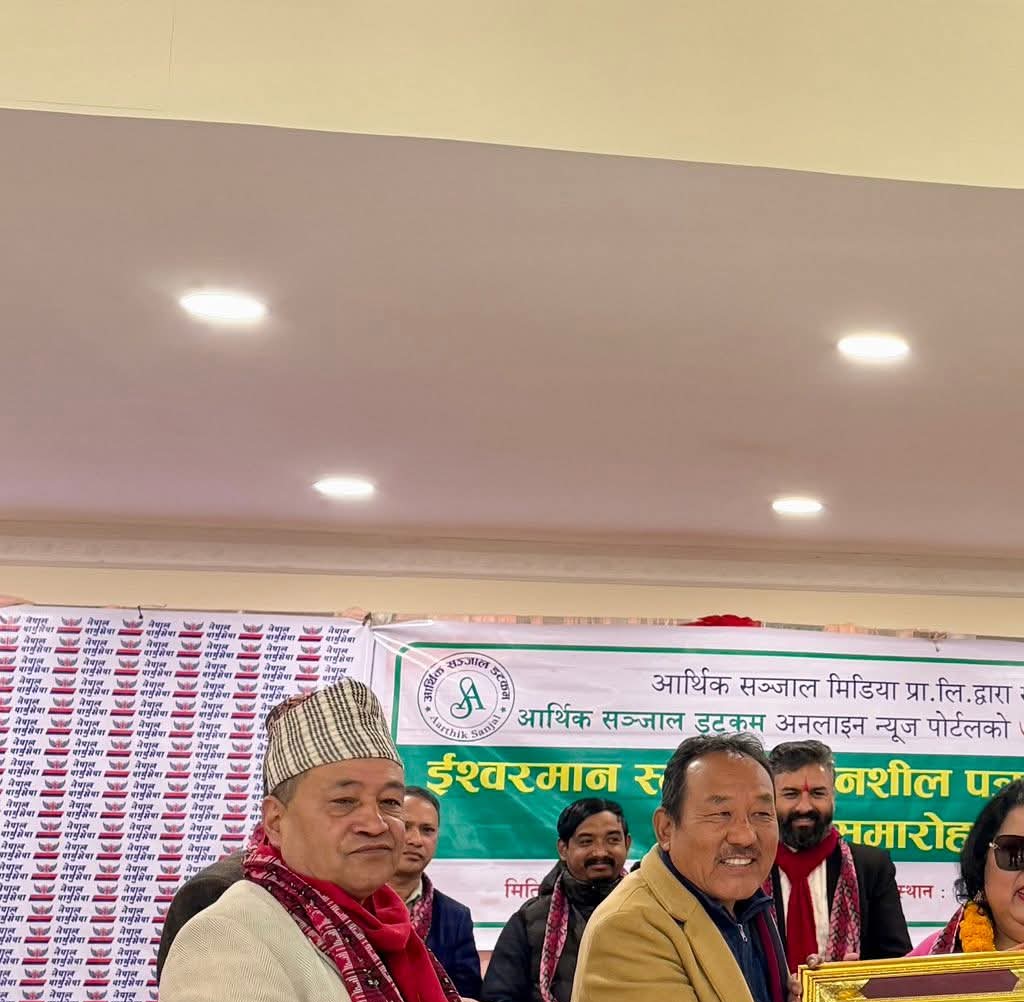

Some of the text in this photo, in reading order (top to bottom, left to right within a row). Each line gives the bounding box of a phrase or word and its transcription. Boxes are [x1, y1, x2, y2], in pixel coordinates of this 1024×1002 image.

[424, 666, 444, 702] आर्थिक
[446, 657, 490, 669] सञ्जाल
[652, 668, 732, 695] आर्थिक
[740, 676, 820, 697] सञ्जाल
[827, 675, 900, 699] मिडिया
[430, 715, 501, 739] Aarthik Sanjal
[518, 702, 593, 730] आर्थिक
[603, 711, 685, 732] सञ्जाल
[776, 713, 865, 737] अनलाइन
[875, 717, 920, 743] न्यूज
[927, 711, 1012, 739] पोर्टलको
[427, 753, 621, 796] ईश्वरमान
